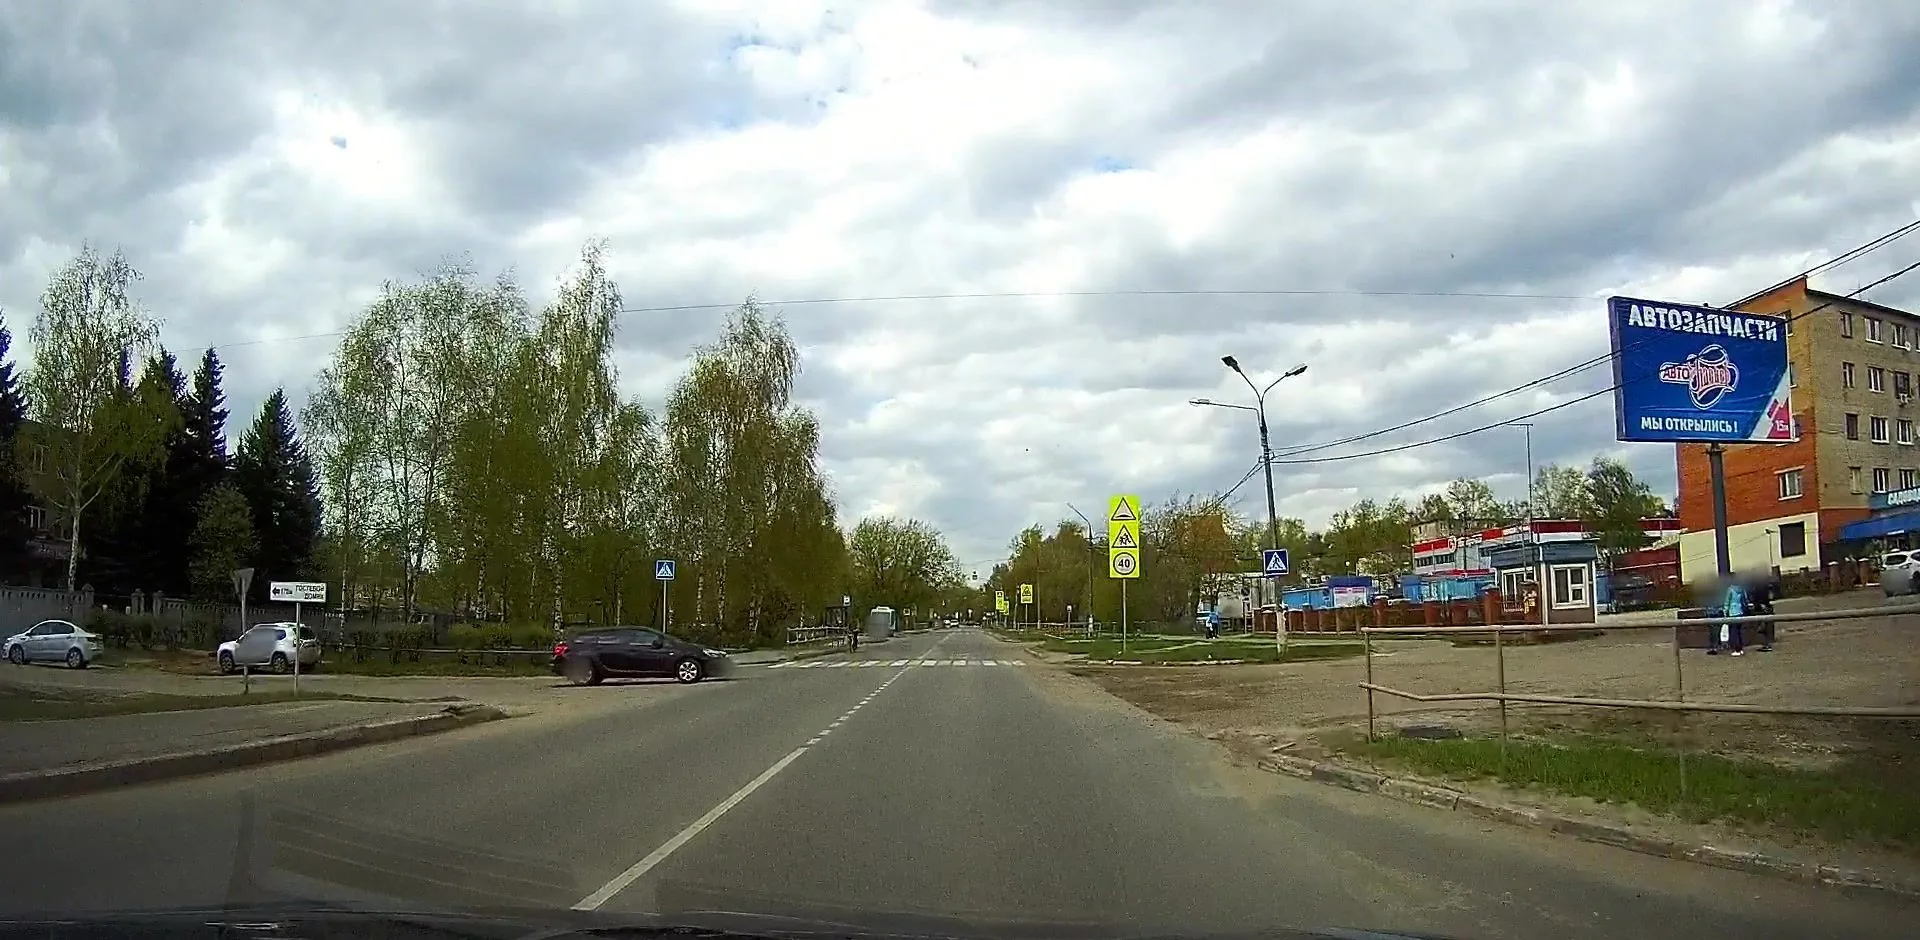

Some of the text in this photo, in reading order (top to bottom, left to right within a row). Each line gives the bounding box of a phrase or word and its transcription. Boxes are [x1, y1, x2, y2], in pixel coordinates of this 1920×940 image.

[1629, 305, 1777, 341] АВТОЗАПЧАСТИ
[1641, 417, 1662, 430] МЫ
[1118, 559, 1130, 568] 40
